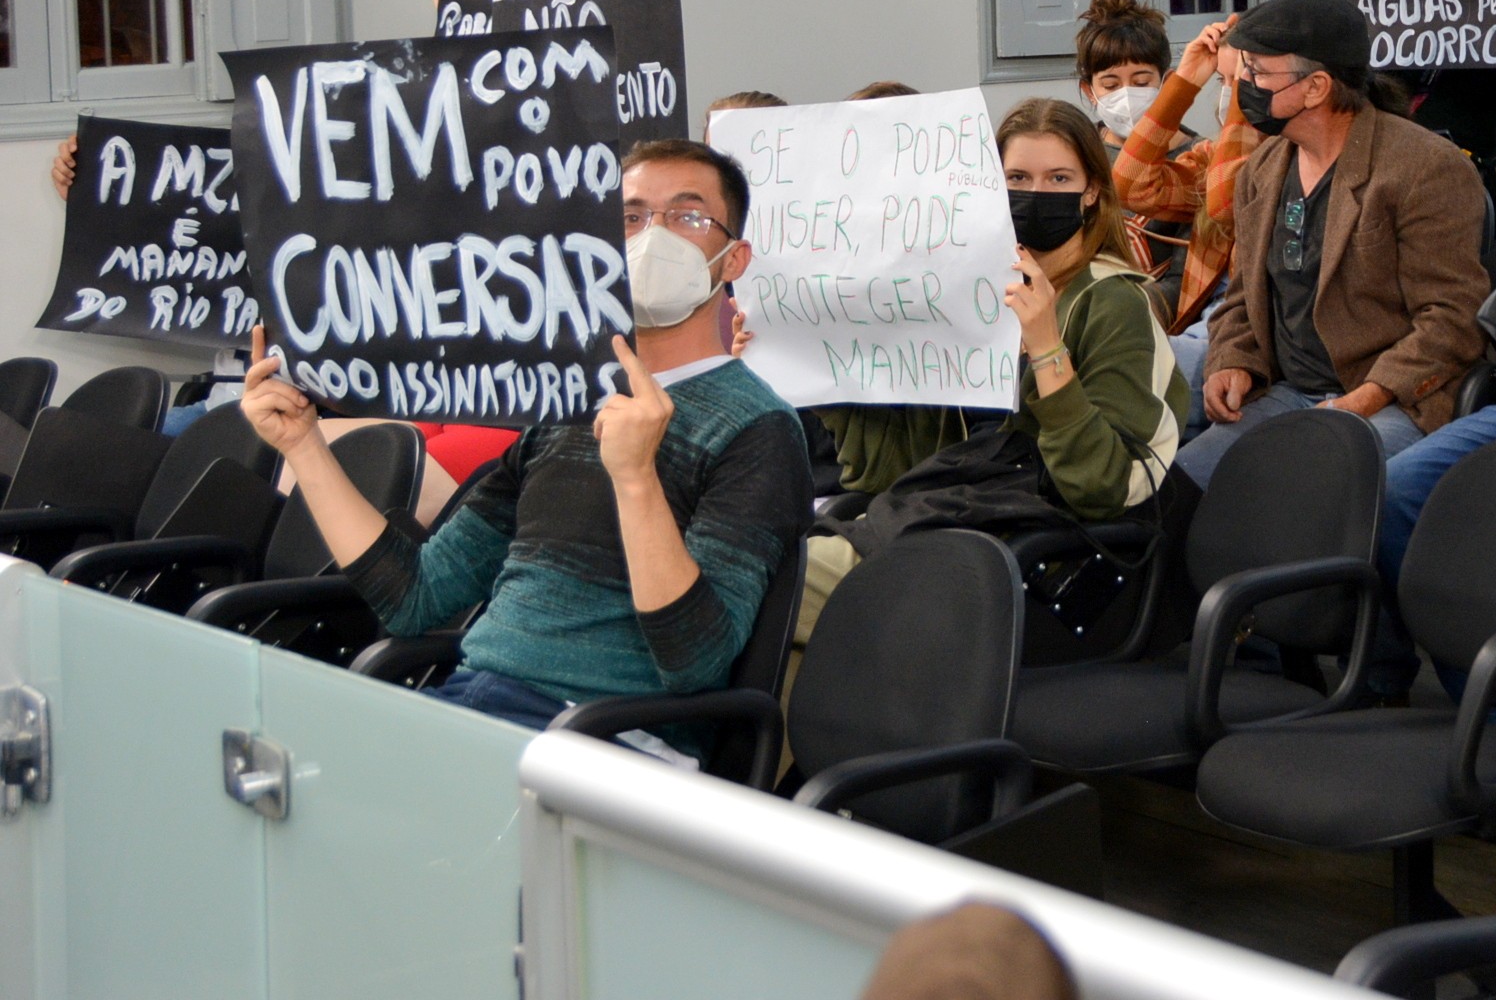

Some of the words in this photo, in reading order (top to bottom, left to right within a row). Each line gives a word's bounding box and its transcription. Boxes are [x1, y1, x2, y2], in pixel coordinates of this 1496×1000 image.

[439, 1, 493, 37] PAR
[471, 39, 609, 103] COM
[256, 60, 474, 202] VEM
[749, 128, 795, 187] SE
[841, 126, 860, 177] O
[893, 113, 997, 177] PODER
[101, 136, 136, 205] A
[152, 145, 240, 214] MZ
[484, 143, 620, 210] POVO
[948, 170, 999, 191] PÚBLICO
[172, 207, 202, 249] É
[882, 192, 971, 254] PODE
[99, 244, 251, 282] MANAN
[273, 232, 633, 352] CONVERSAR
[222, 286, 264, 337] PA
[751, 271, 952, 326] PROTEGER
[974, 277, 1000, 325] O
